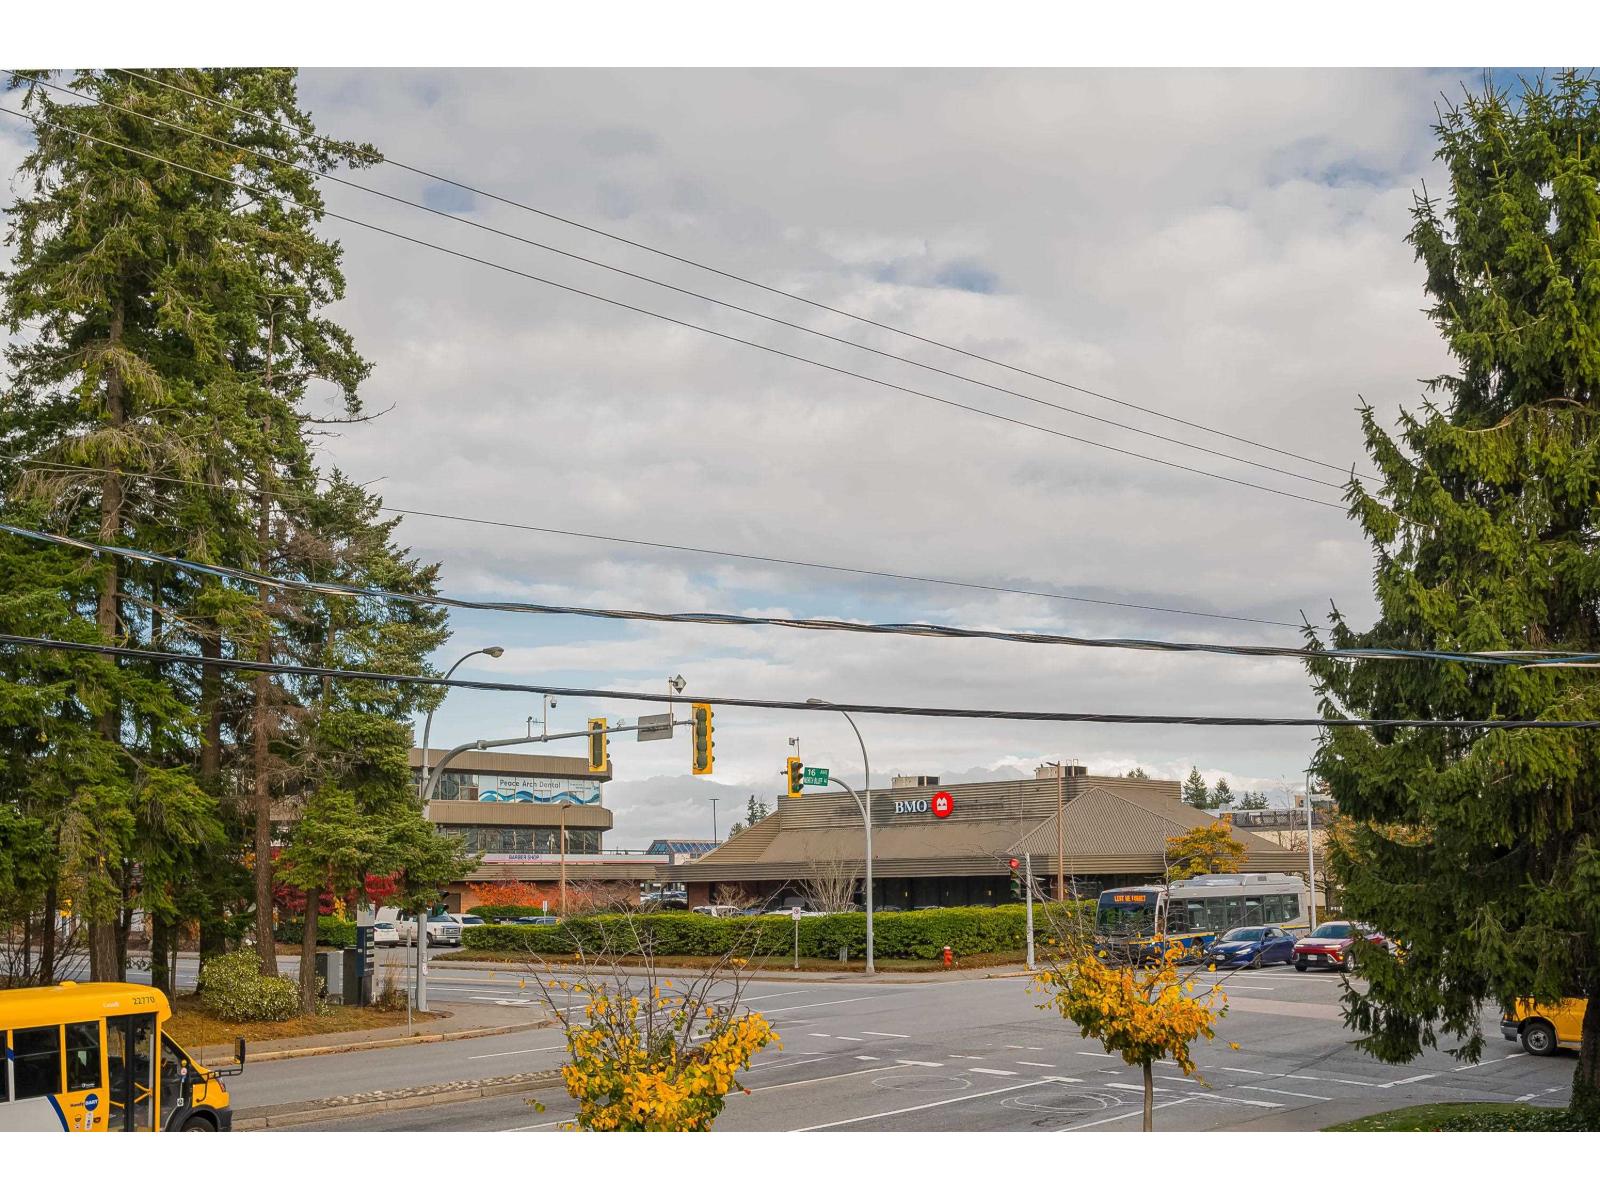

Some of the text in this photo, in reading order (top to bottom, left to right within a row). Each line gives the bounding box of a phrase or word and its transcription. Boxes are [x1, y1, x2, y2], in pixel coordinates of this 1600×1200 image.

[808, 769, 816, 777] 16
[500, 779, 520, 787] Peace
[522, 780, 537, 788] Arch
[539, 781, 561, 789] Dental
[895, 799, 928, 814] BMO
[132, 996, 155, 1005] 22770
